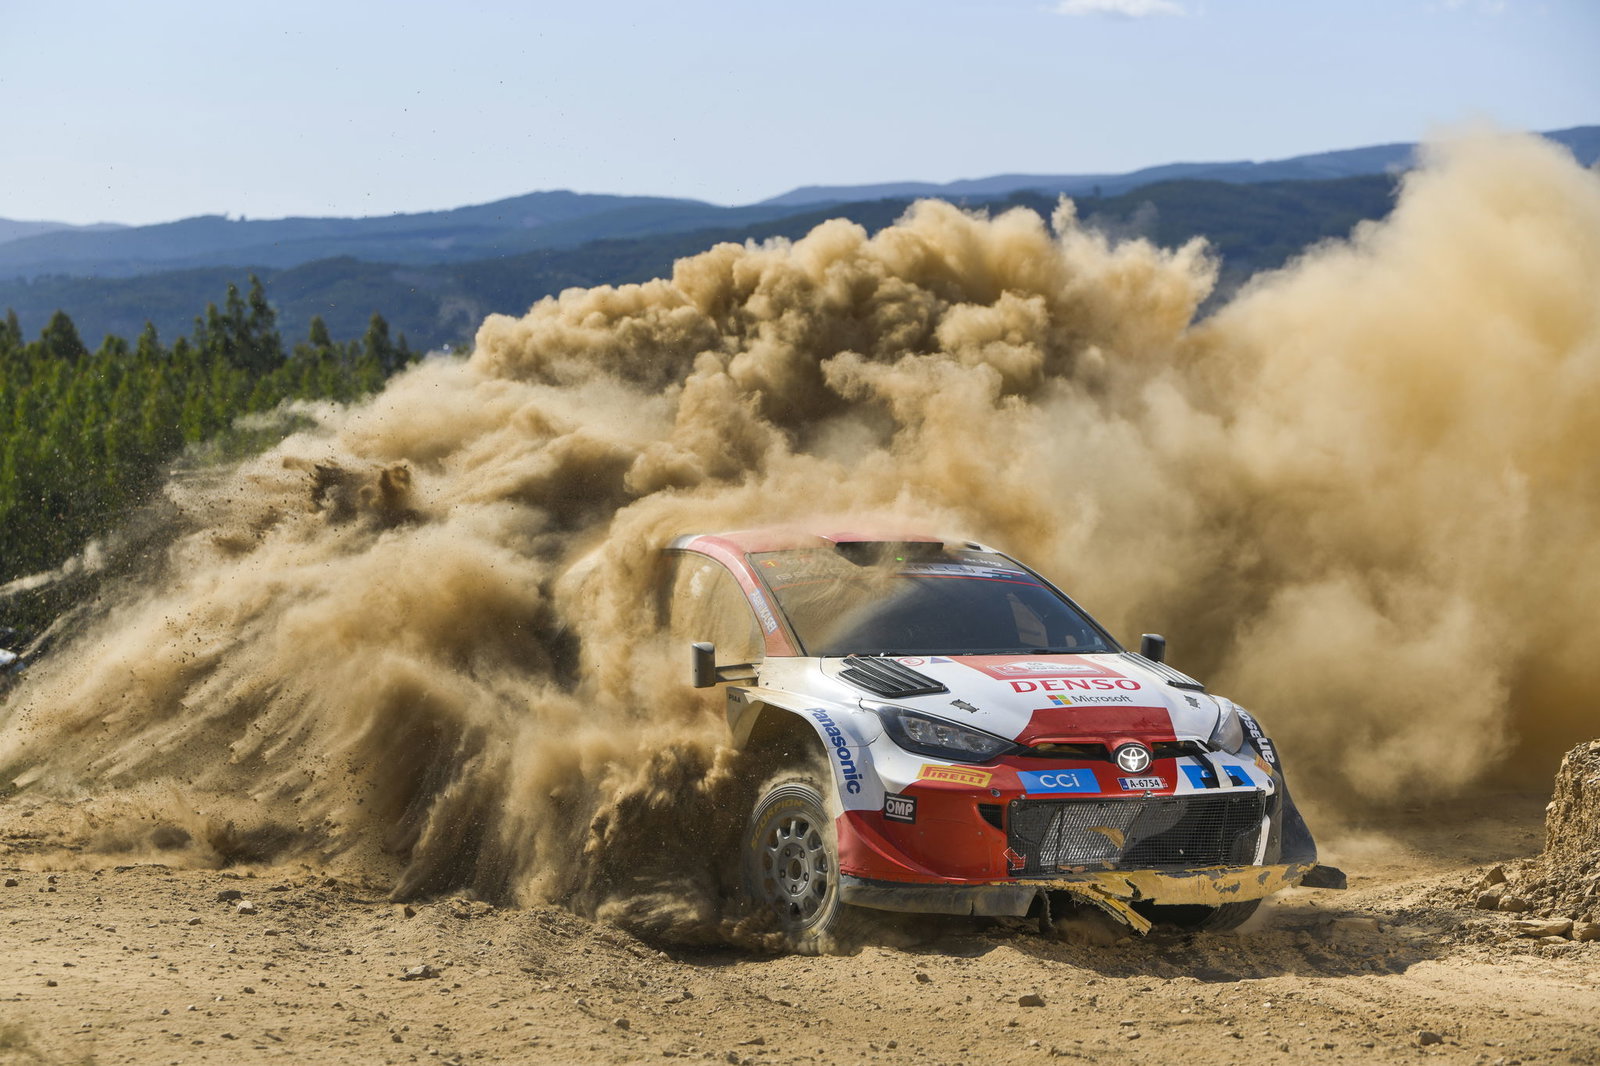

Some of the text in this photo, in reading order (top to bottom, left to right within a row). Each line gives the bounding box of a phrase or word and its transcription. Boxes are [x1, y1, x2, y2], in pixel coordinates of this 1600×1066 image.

[1009, 679, 1142, 693] DENSO
[1071, 694, 1133, 704] Microsoft
[804, 707, 863, 794] Panasonic
[922, 766, 986, 785] PIRELLI
[1129, 779, 1160, 788] A-6754
[886, 799, 914, 816] OMP
